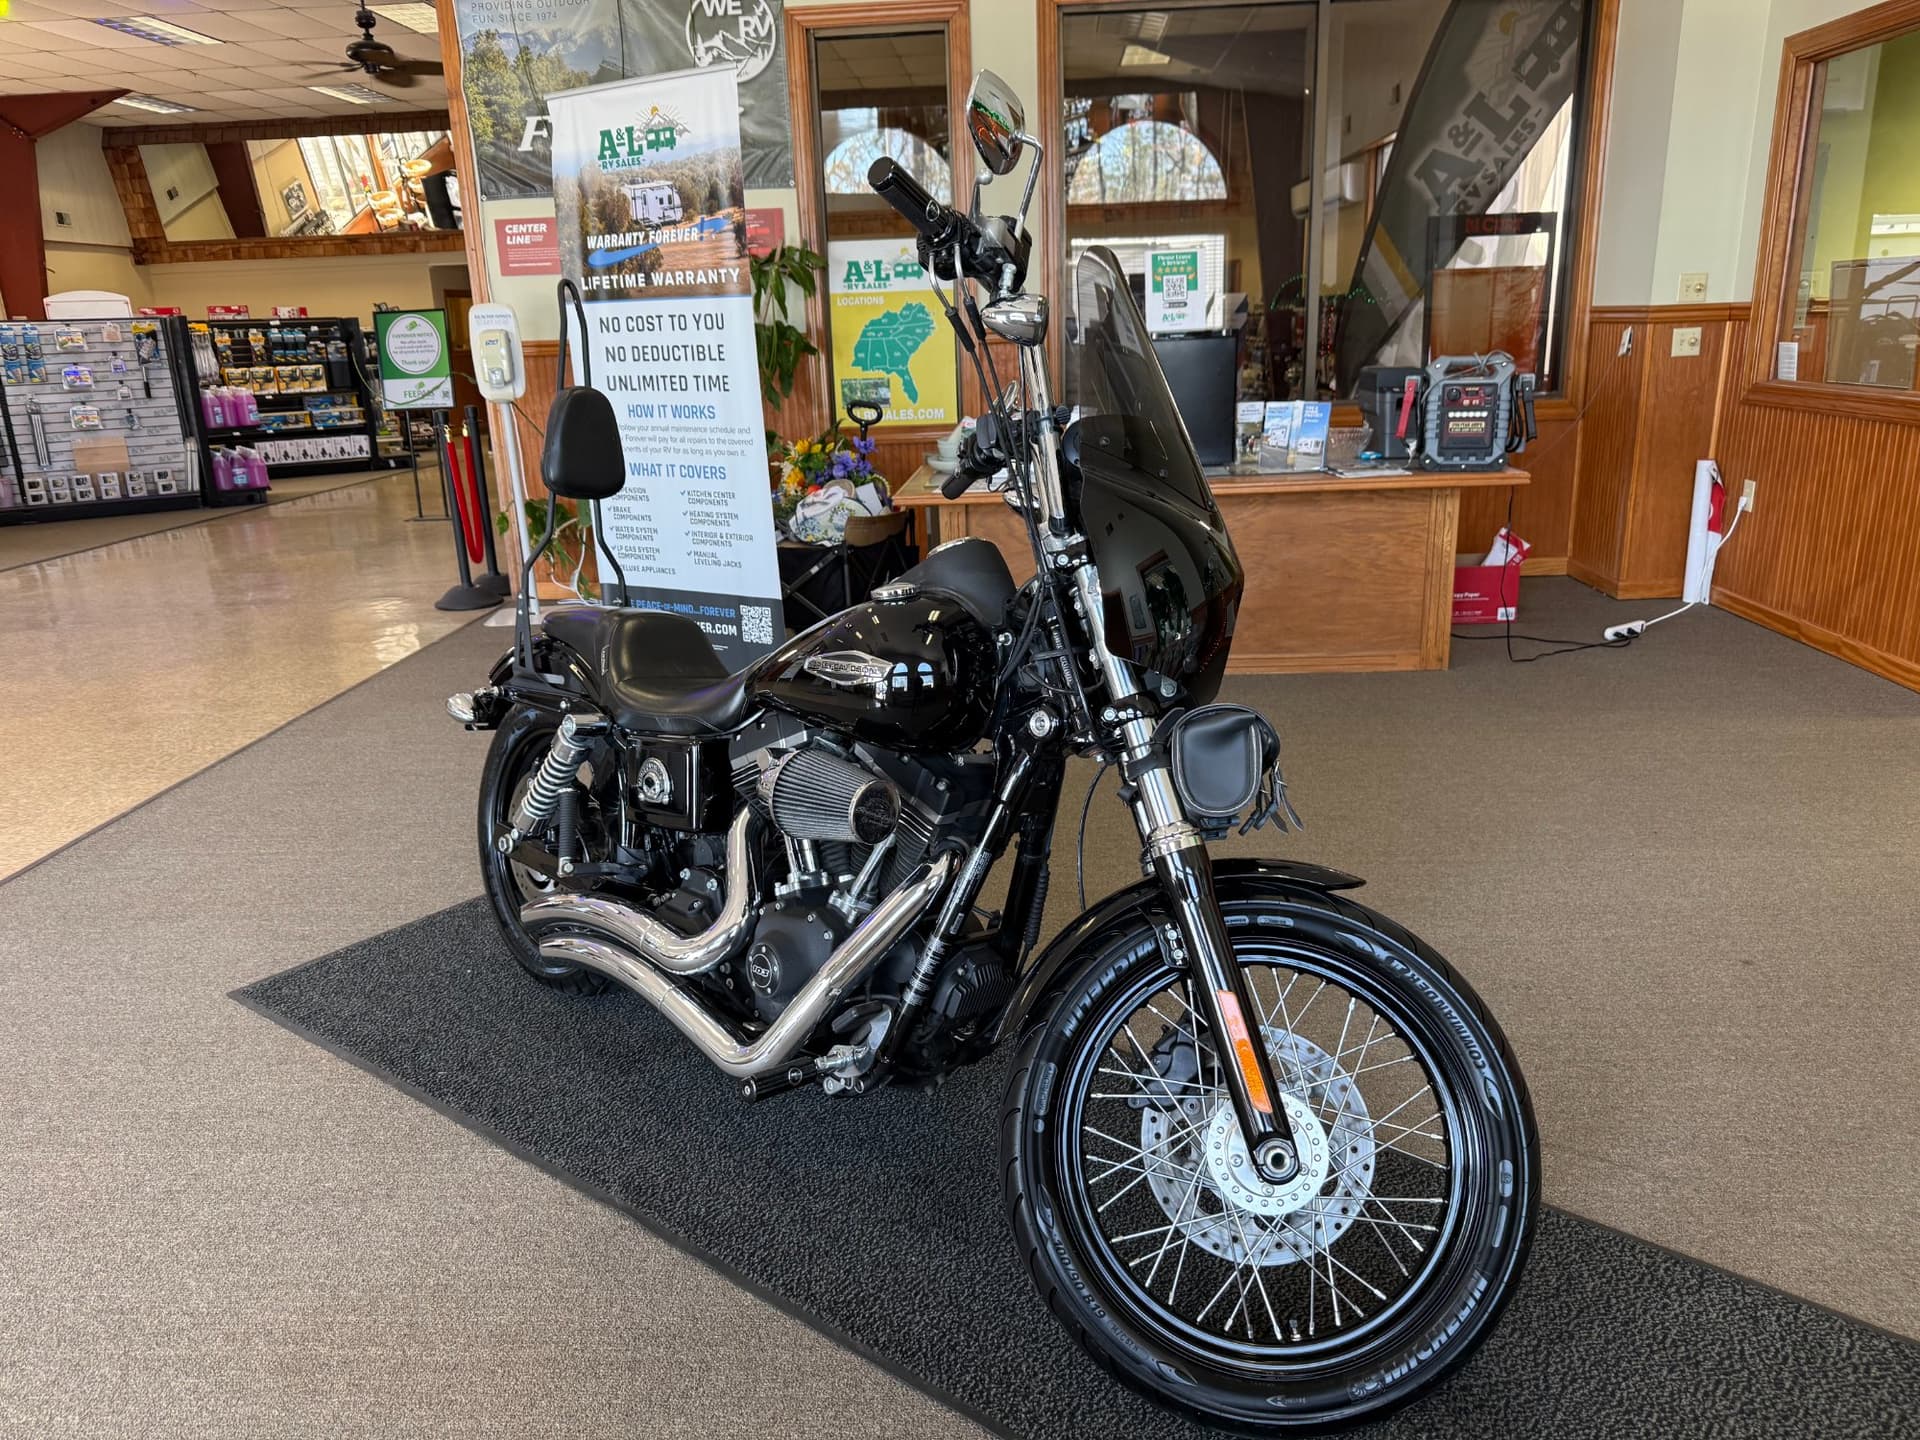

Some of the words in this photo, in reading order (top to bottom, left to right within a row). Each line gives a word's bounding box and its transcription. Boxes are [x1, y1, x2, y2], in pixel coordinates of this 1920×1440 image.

[471, 0, 532, 11] PROVIDING
[701, 0, 742, 17] WE
[472, 14, 494, 23] FUN
[499, 12, 532, 22] SINCE
[536, 11, 558, 21] 1974
[738, 15, 772, 38] RV
[598, 125, 644, 160] A&L
[616, 156, 642, 167] SALES
[505, 223, 547, 233] CENTER
[506, 235, 531, 245] LINE
[586, 230, 646, 249] WARRANTY
[843, 259, 890, 283] A&L
[581, 272, 646, 291] LIFETIME
[651, 267, 740, 285] WARRANTY
[861, 282, 888, 290] SALES
[836, 296, 885, 306] LOCATIONS
[599, 316, 621, 333] NO
[625, 314, 663, 332] COST
[668, 314, 688, 331] TO
[692, 313, 725, 330] YOU
[605, 346, 627, 362] NO
[632, 344, 726, 362] DEDUCTIBLE
[606, 375, 688, 392] UNLIMITED
[693, 375, 730, 392] TIME
[627, 404, 654, 419] HOW
[657, 404, 667, 418] IT
[671, 404, 716, 420] WORKS
[628, 461, 662, 477] WHAT
[666, 464, 676, 478] IT
[679, 464, 726, 480] COVERS
[687, 490, 712, 498] KITCHEN
[713, 491, 736, 499] CENTER
[687, 497, 729, 506] COMPONENTS
[613, 513, 652, 521] COMPONENTS
[689, 510, 714, 518] HEATING
[715, 512, 739, 520] SYSTEM
[690, 518, 731, 527] COMPONENTS
[635, 527, 659, 535] SYSTEM
[615, 533, 655, 541] COMPONENTS
[725, 533, 754, 541] EXTERIOR
[691, 538, 733, 547] COMPONENTS
[637, 546, 661, 554] SYSTEM
[693, 550, 718, 559] MANUAL
[617, 552, 657, 561] COMPONENTS
[694, 558, 722, 567] LEVELING
[722, 560, 742, 568] JACKS
[641, 566, 676, 575] APPLIANCES
[752, 964, 770, 977] 103
[1408, 968, 1487, 1070] COMMANDER
[1054, 1239, 1086, 1291] 100/90
[1083, 1295, 1107, 1319] B19
[1381, 1270, 1488, 1385] MICHELIN
